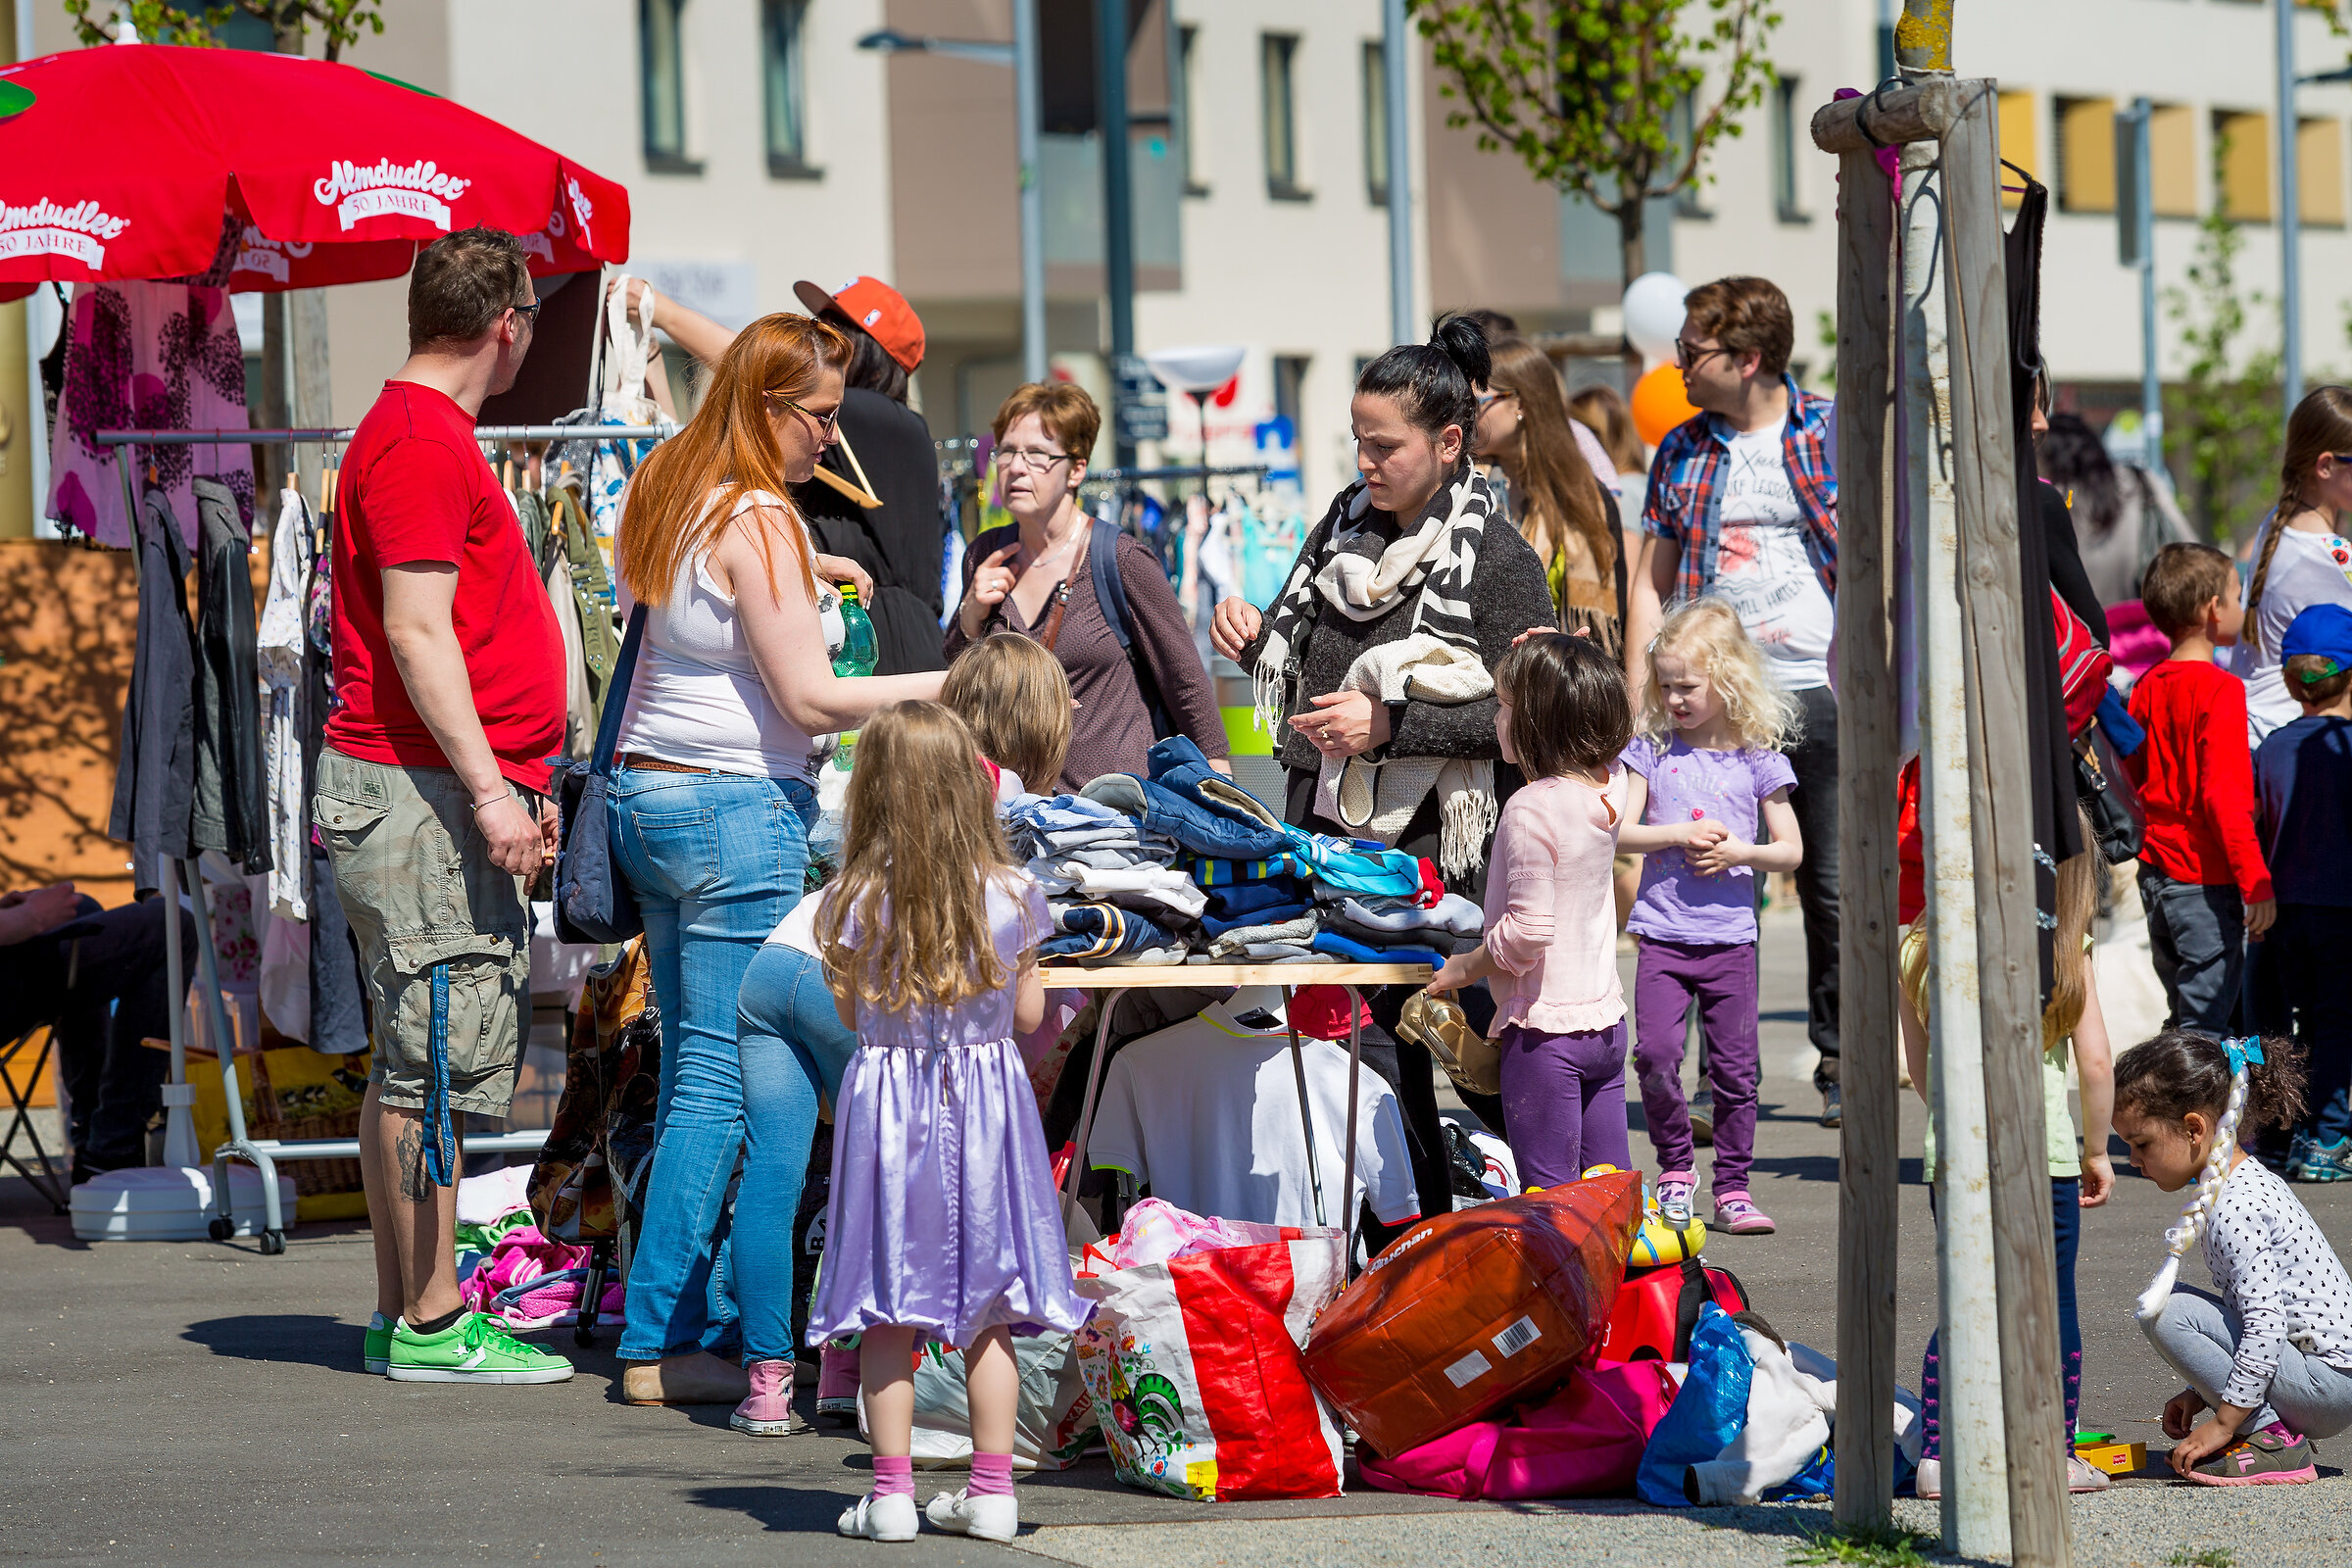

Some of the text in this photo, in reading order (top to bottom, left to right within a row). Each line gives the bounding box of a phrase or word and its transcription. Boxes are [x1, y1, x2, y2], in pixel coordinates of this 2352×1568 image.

[314, 157, 465, 206] Almdudler
[353, 194, 432, 214] 50 JAHRE
[25, 234, 87, 255] JAHRE
